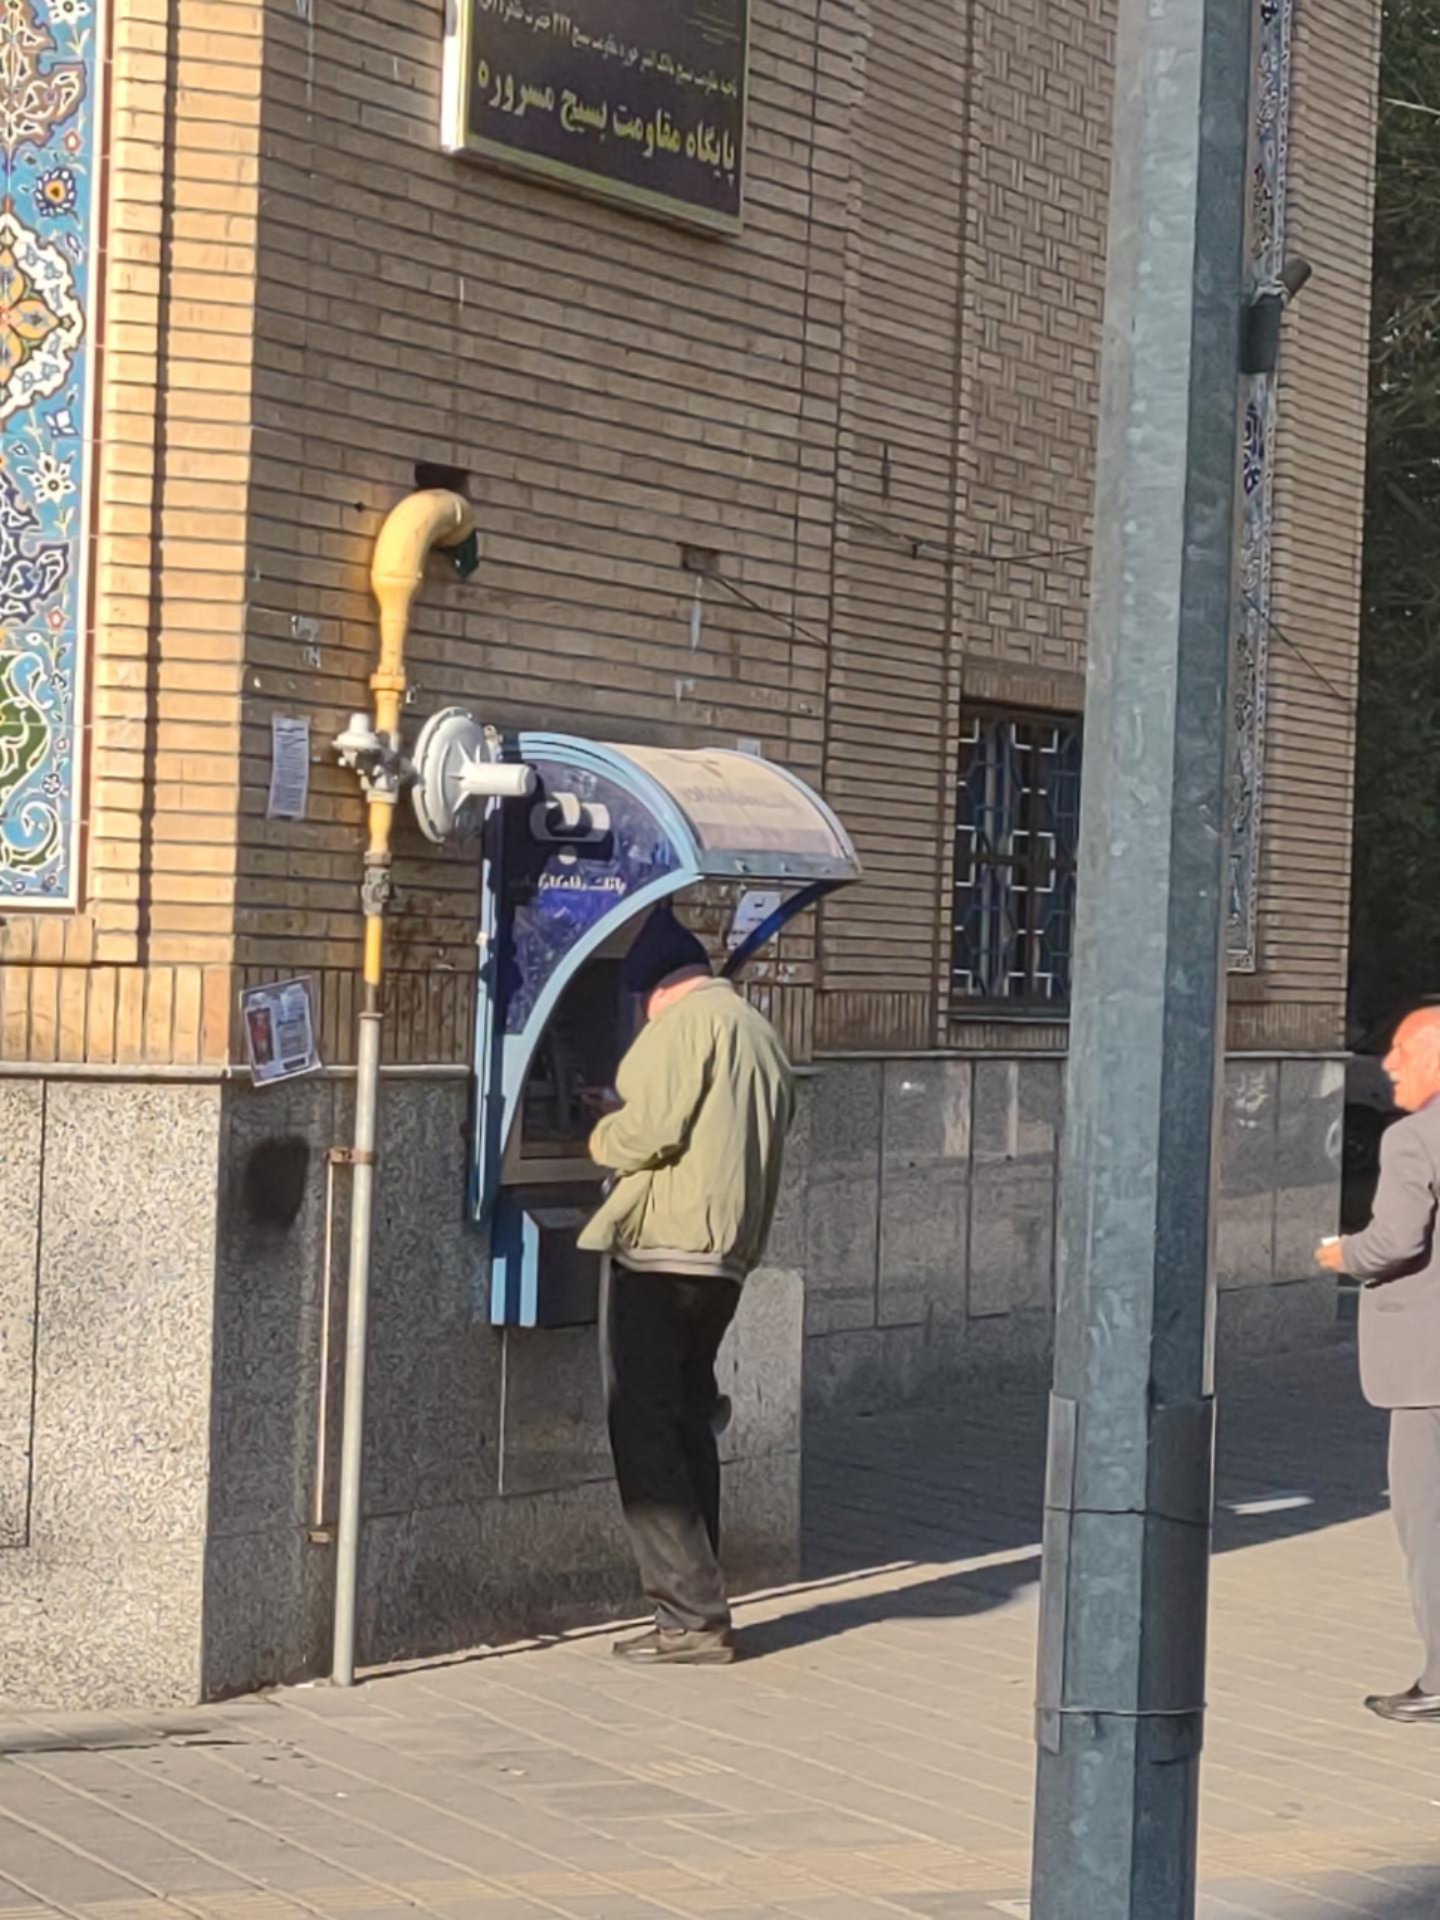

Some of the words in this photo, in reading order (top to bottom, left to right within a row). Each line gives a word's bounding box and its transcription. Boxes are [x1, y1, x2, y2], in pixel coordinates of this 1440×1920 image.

[560, 87, 608, 141] بسیج
[612, 104, 682, 158] مقاومت
[685, 118, 736, 188] پایگاه
[588, 875, 627, 896] بانک
